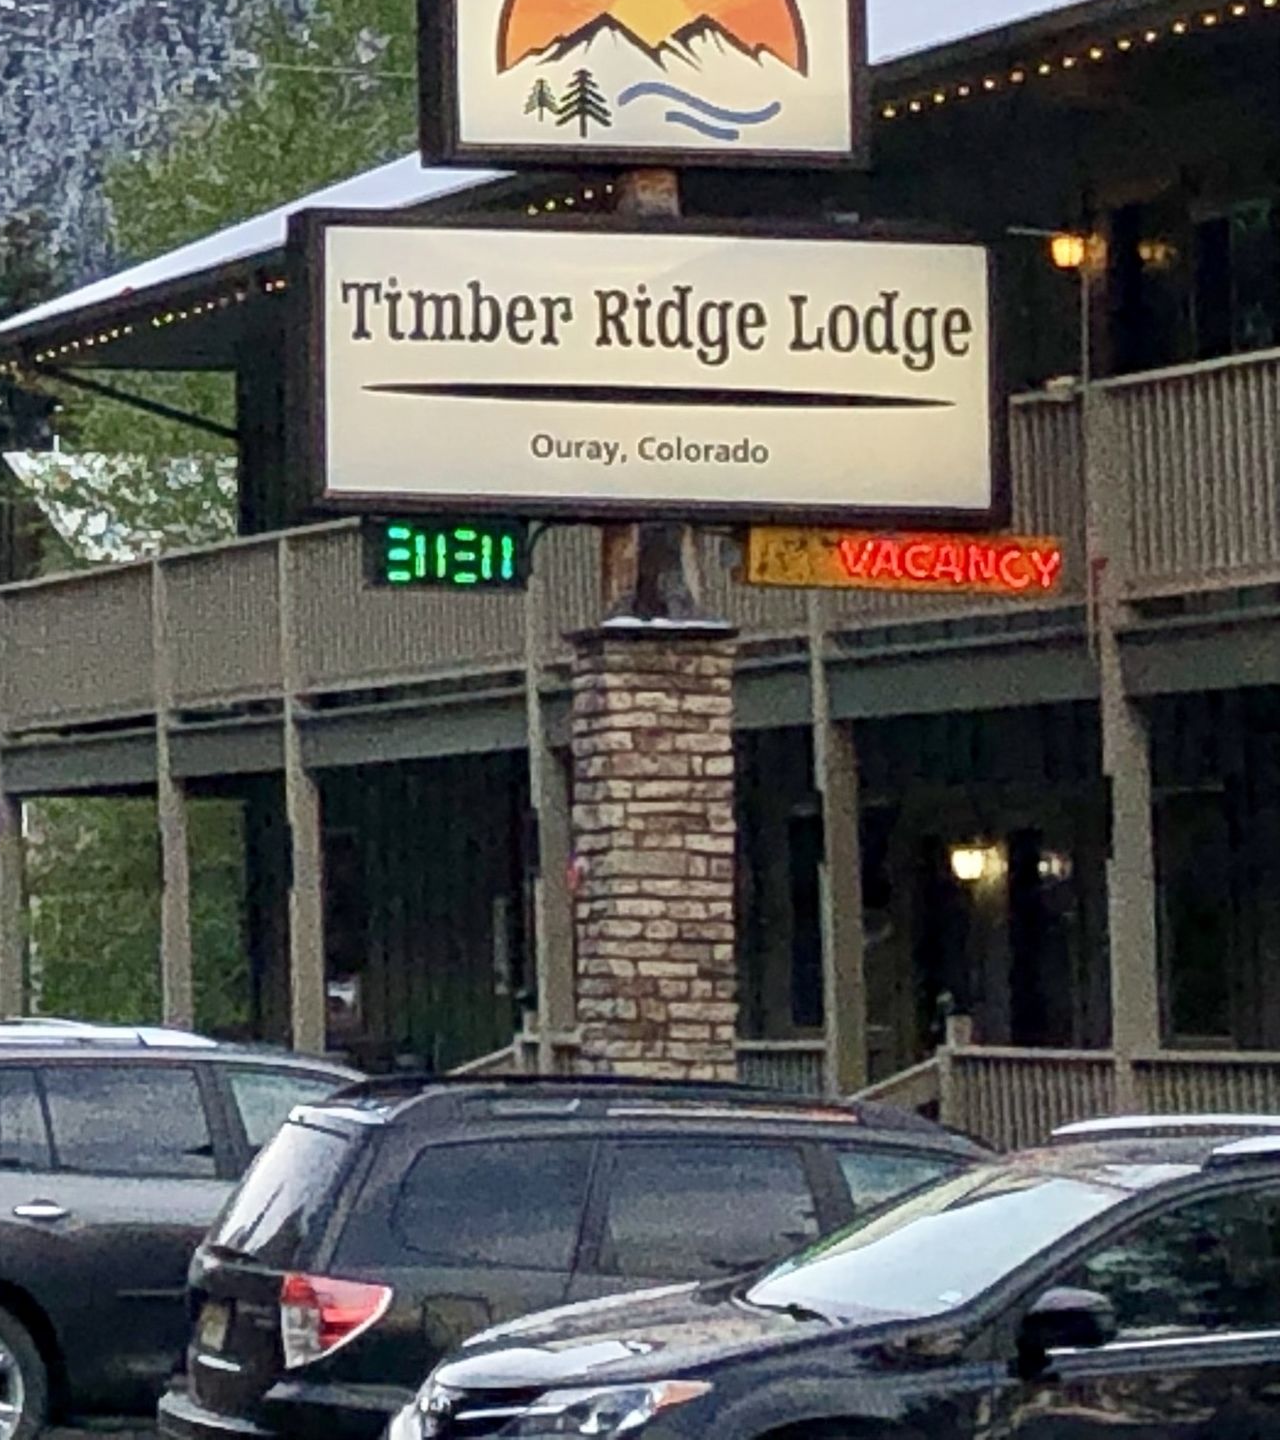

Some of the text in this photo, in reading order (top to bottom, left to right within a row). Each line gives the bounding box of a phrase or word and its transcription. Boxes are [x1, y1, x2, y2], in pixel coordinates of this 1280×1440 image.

[341, 277, 972, 371] Timber Ridge Lodge
[531, 433, 769, 466] Ouray, Colorado
[841, 538, 1061, 589] VACANCY
